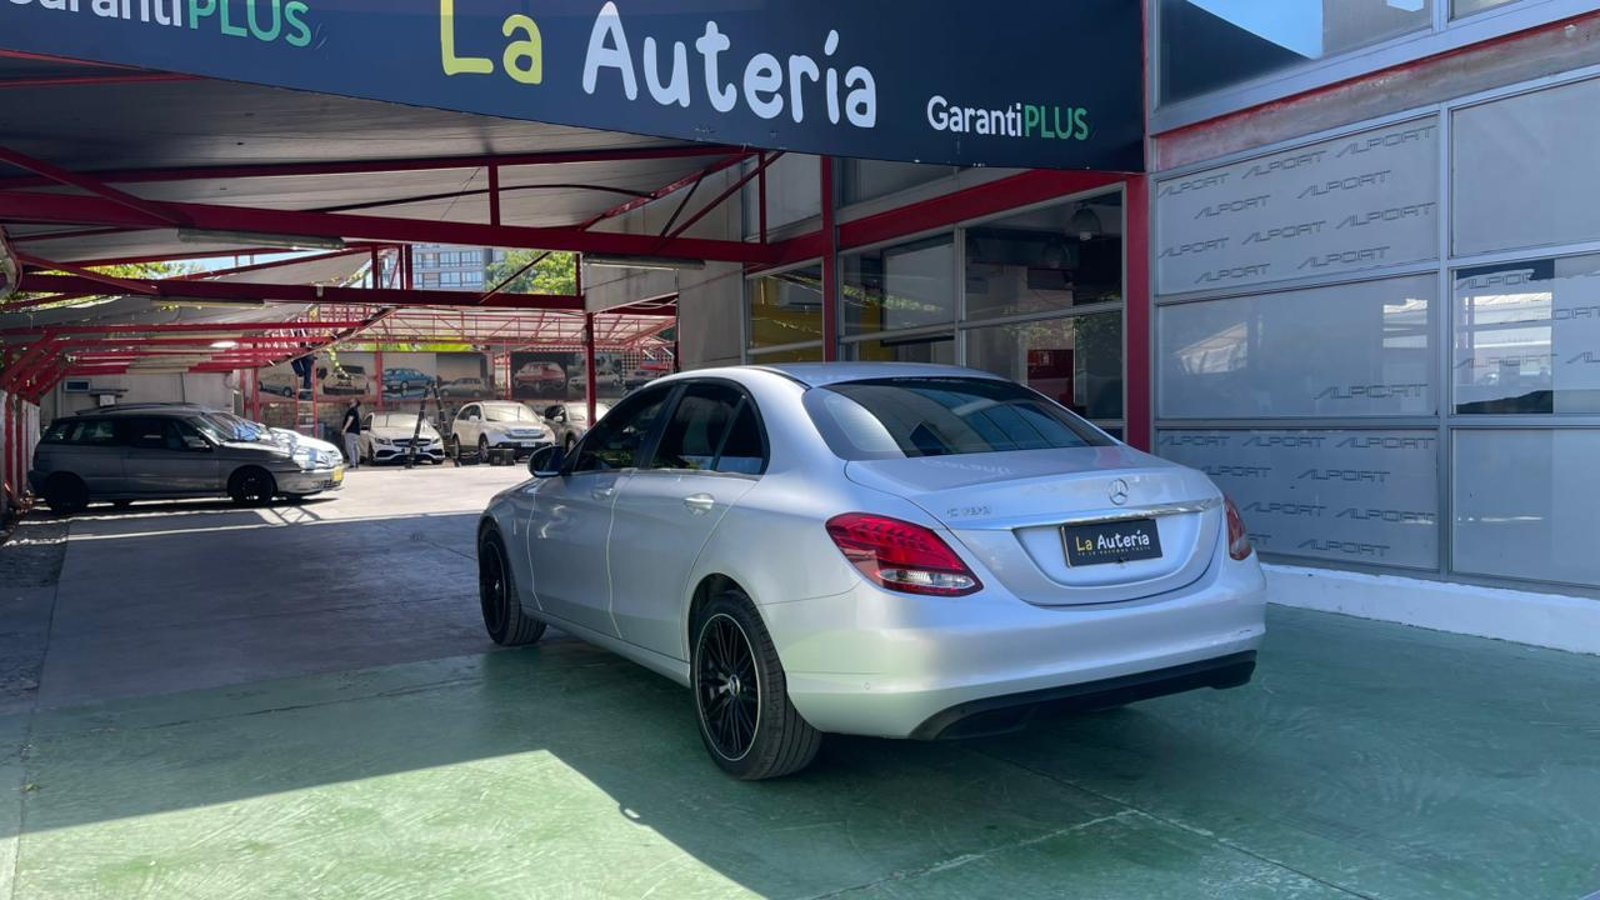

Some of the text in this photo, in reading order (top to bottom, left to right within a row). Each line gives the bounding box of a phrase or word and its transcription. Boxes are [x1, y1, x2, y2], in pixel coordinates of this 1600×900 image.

[440, 0, 877, 128] La Autería
[927, 95, 1090, 141] GarantiPLUS
[1075, 535, 1093, 552] La
[1097, 529, 1150, 550] Autería
